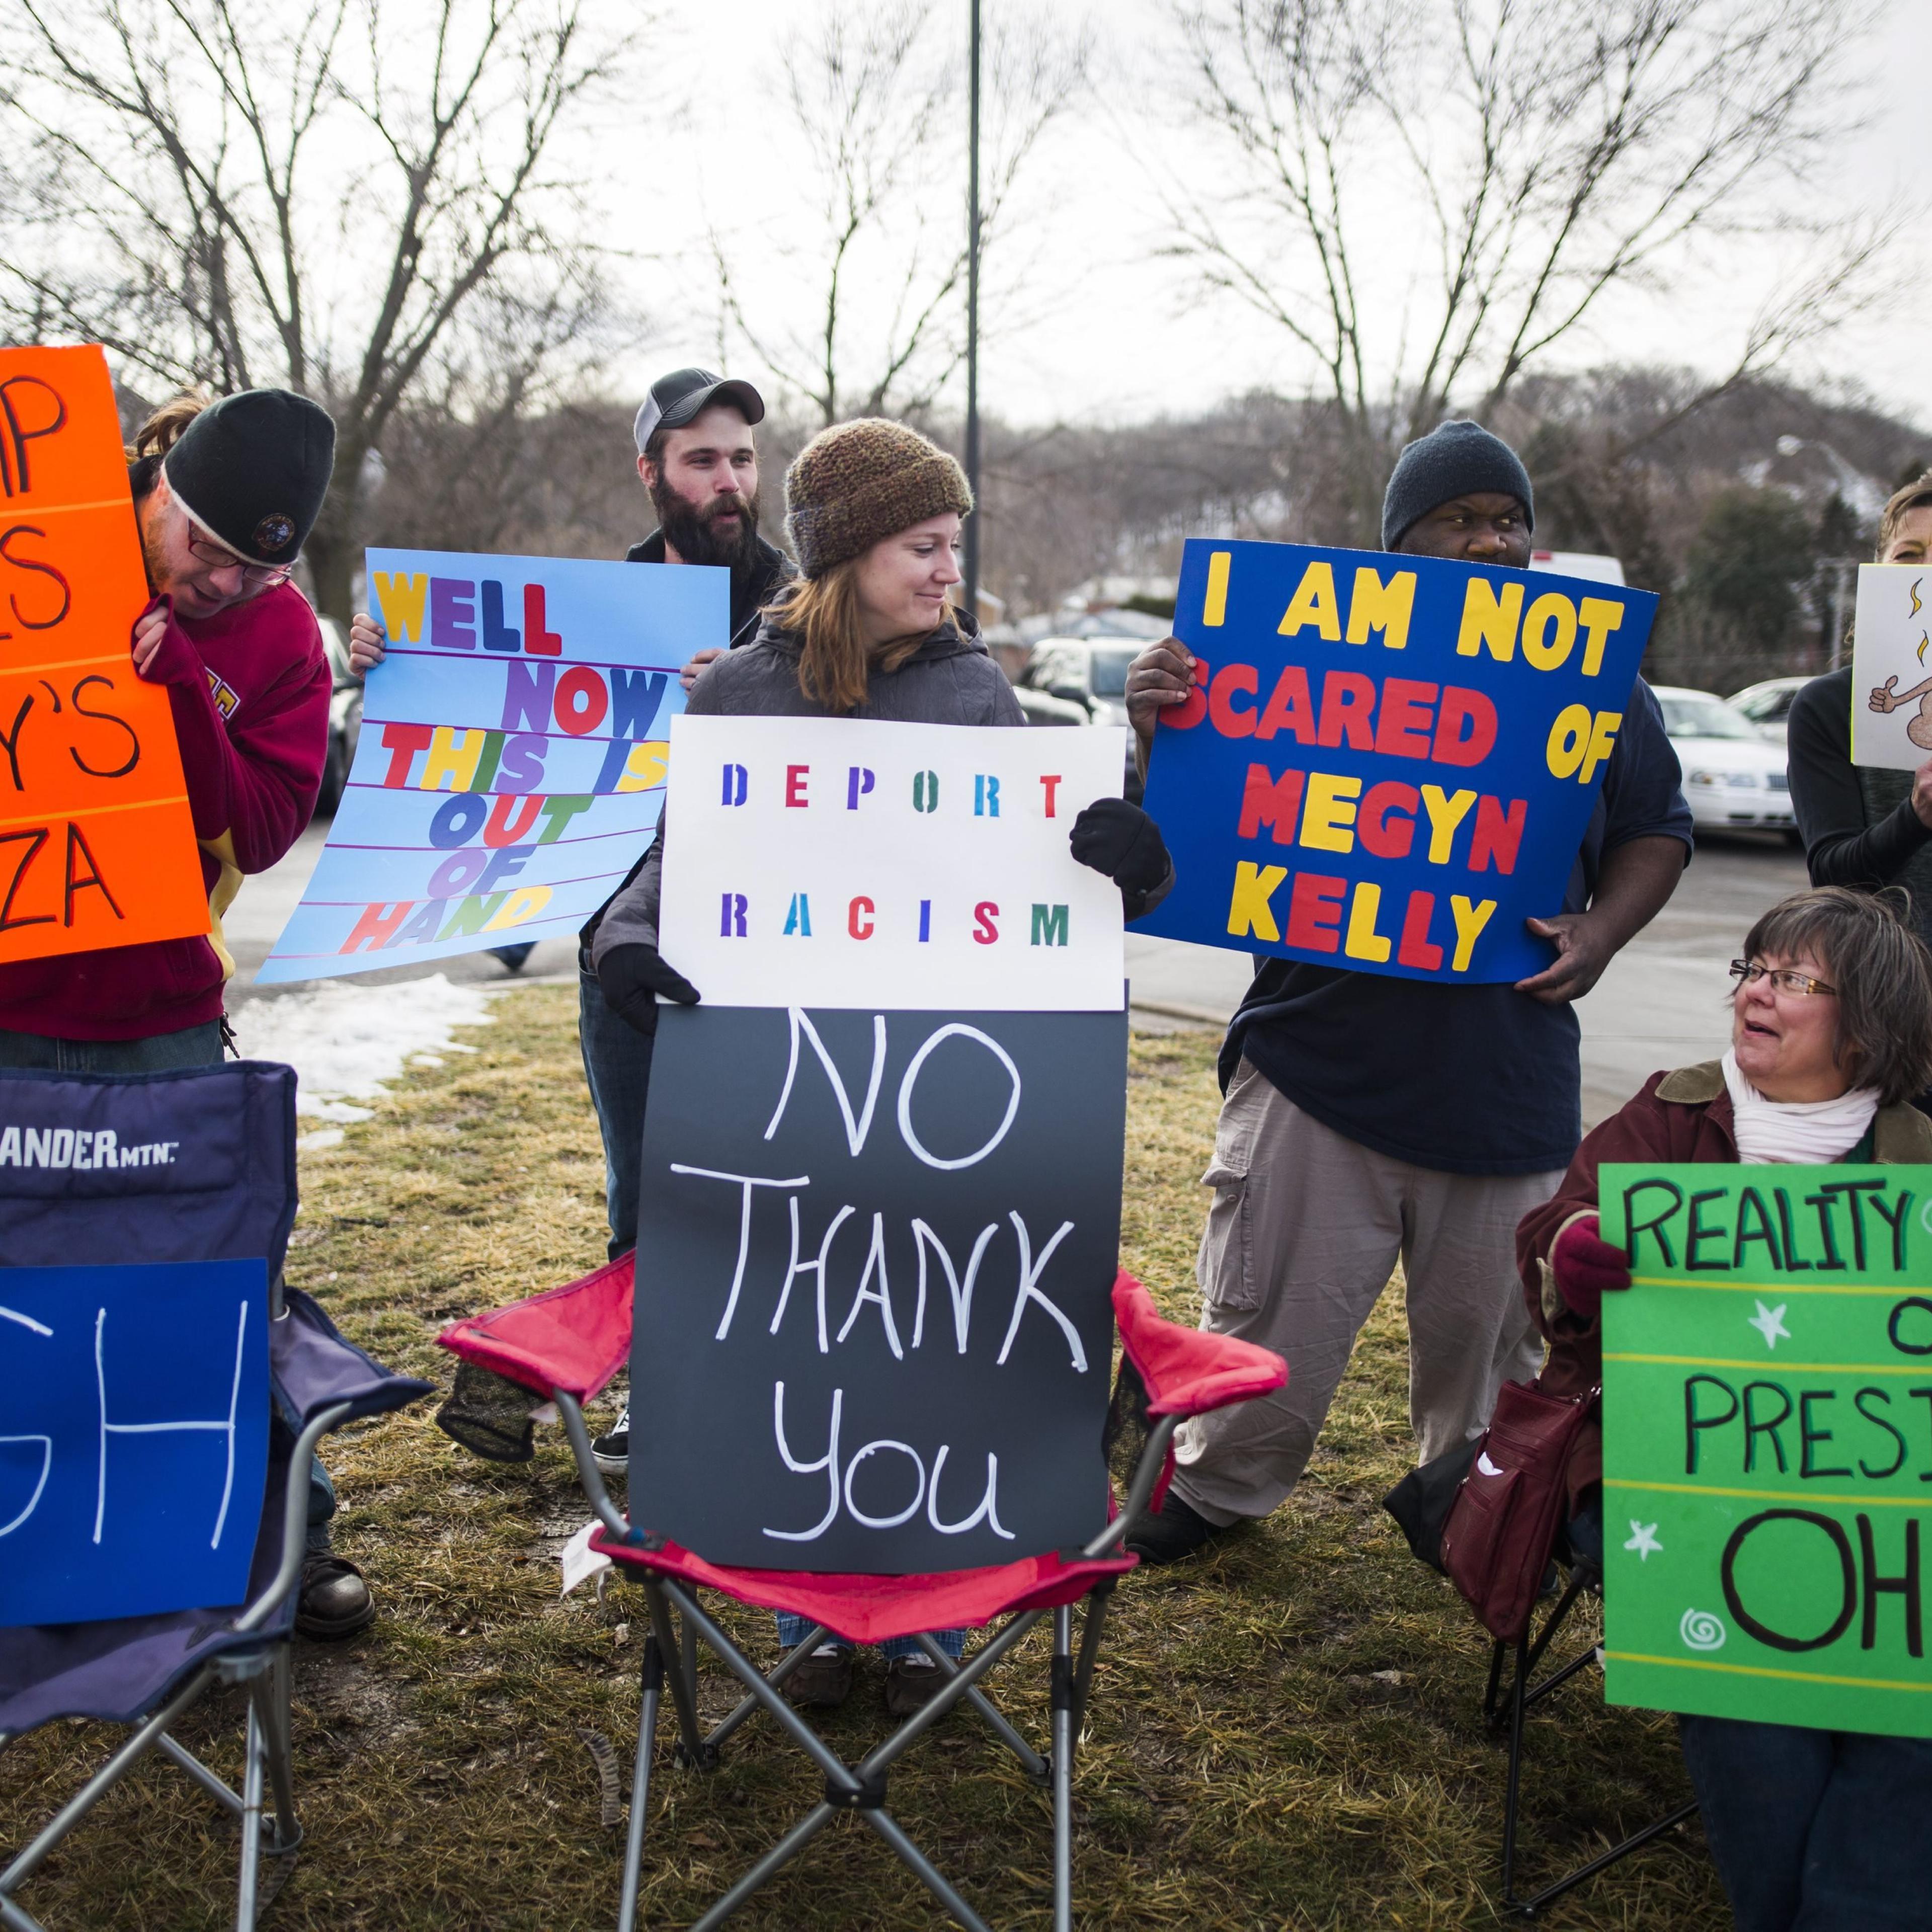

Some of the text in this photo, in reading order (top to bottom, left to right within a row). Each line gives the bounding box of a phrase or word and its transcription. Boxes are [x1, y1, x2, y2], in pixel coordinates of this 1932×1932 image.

[0, 375, 68, 498] P
[373, 571, 562, 656] WELL
[1203, 552, 1625, 676] I AM NOT
[501, 660, 668, 740] NOW
[1158, 657, 1623, 784] SCARED OF
[381, 723, 670, 795] THIS IS
[721, 763, 1062, 819] DEPORT
[429, 791, 596, 849] OUT
[1237, 764, 1527, 875] MEGYN
[337, 885, 553, 954] HAND
[427, 844, 537, 900] OF
[719, 892, 1069, 947] RACISM
[1227, 860, 1497, 972] KELLY
[763, 1006, 1021, 1170] NO
[670, 1163, 1088, 1373] THANK
[1622, 1178, 1915, 1273] REALITY
[1722, 1508, 1923, 1658] OH
